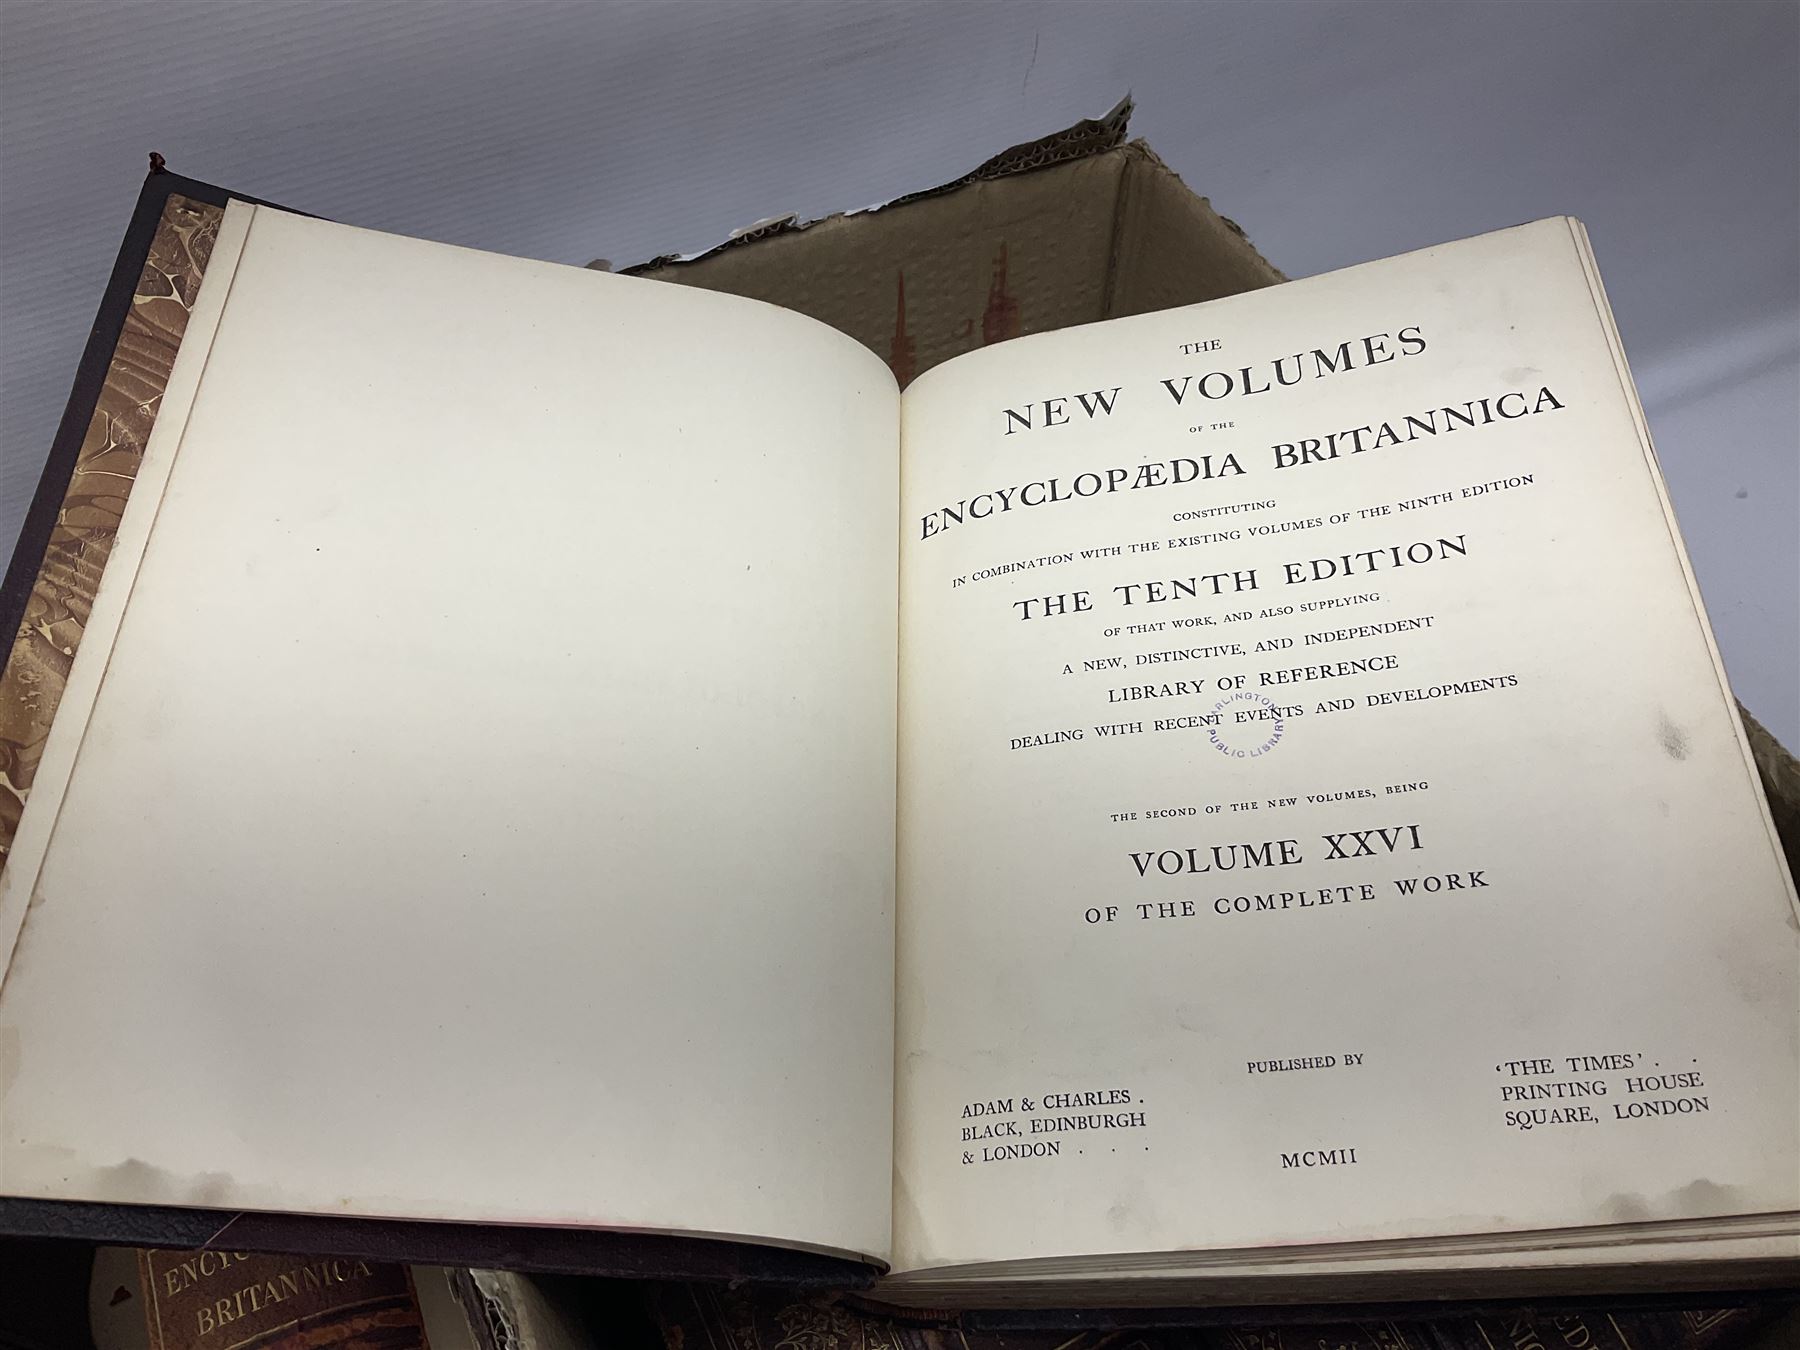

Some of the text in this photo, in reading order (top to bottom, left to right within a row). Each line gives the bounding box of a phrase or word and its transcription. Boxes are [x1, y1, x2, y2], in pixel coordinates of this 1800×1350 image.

[1178, 338, 1223, 356] THE
[1001, 325, 1427, 436] NEW VOLUMES
[1189, 421, 1235, 434] OF THE
[919, 386, 1566, 541] ENCYCLOPÆDIA BRITANNICA
[952, 473, 1534, 589] IN COMBINATION WITH THE EXISTING VOLUMES OF THE NINTH EDITION
[1172, 499, 1277, 522] CONSTITUTING
[1012, 533, 1467, 621] THE TENTH EDITION
[1103, 592, 1381, 638] OF THAT WORK, AND ALSO SUPPLYING
[1062, 615, 1435, 675] A NEW, DISTINCTIVE, AND INDEPENDENT
[1107, 654, 1399, 704] LIBRARY OF REFERENCE
[1009, 674, 1519, 751] DEALING WITH RECENT EVENTS AND DEVELOPMENTS
[1207, 717, 1284, 758] PUBLIC LIBRARY
[1110, 781, 1429, 823] THE SECOND OF THE NEW VOLUMES, BEING
[1127, 824, 1424, 878] VOLUME XXVI
[1084, 870, 1490, 924] OF THE COMPLETE WORK
[1246, 1053, 1364, 1074] PUBLISHED BY
[960, 1089, 1131, 1119] ADAM & CHARLES
[1500, 1071, 1705, 1102] PRINTING HOUSE
[961, 1111, 1147, 1142] BLACK, EDINBURGH
[1505, 1096, 1710, 1131] SQUARE, LONDON
[961, 1140, 1061, 1165] & LONDON
[1280, 1148, 1358, 1169] MCMII
[195, 1259, 374, 1337] BRITANNICA
